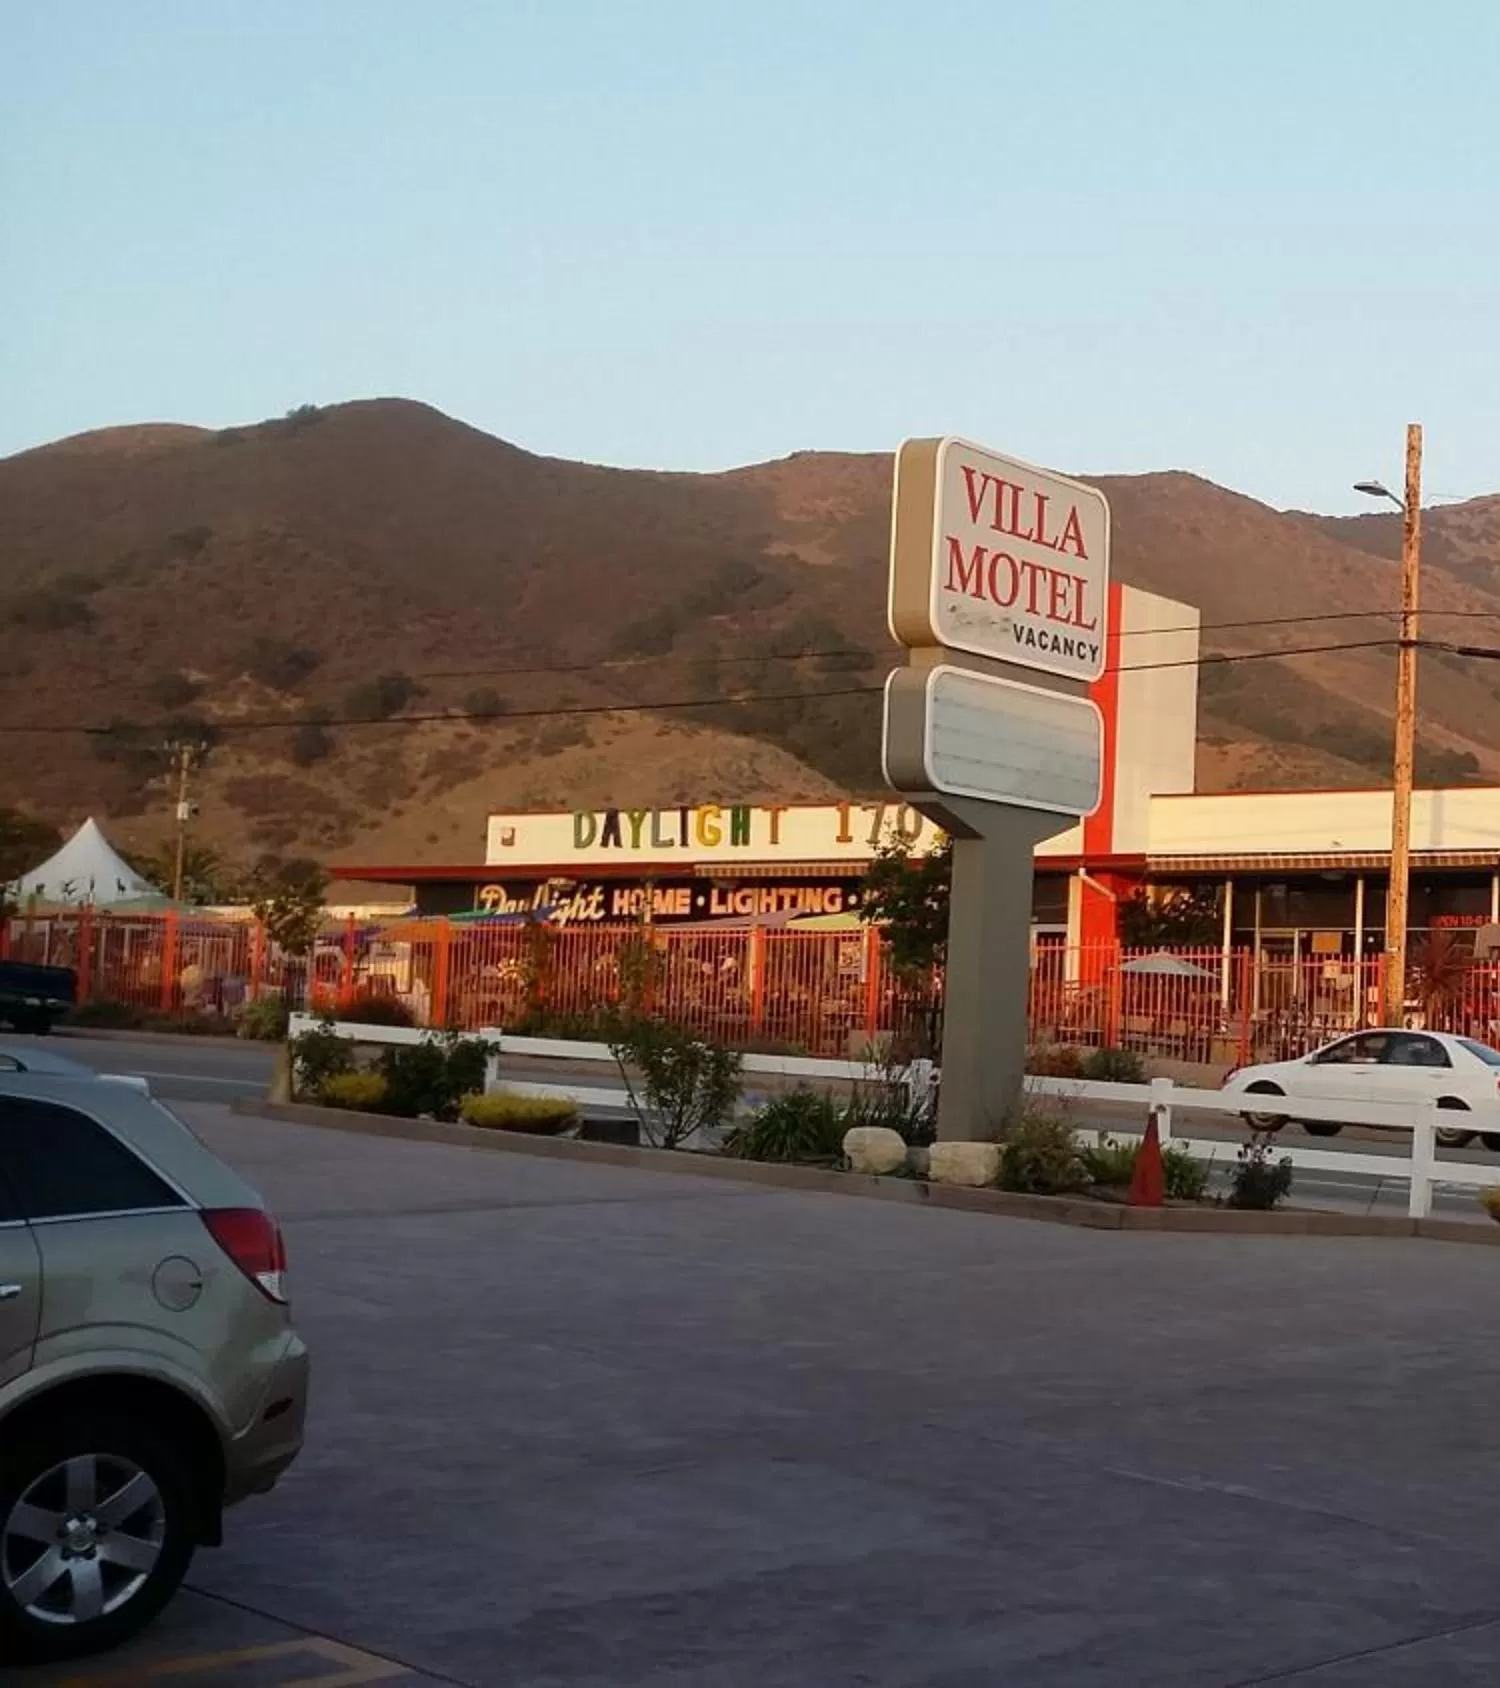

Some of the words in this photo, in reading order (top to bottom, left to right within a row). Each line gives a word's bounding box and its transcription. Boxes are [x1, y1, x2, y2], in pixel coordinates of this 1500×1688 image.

[960, 465, 1089, 561] VILLA
[944, 535, 1098, 632] MOTEL
[1013, 623, 1099, 663] VACANCY
[573, 801, 789, 849] DAYLIGHT
[611, 888, 692, 916] HOME
[709, 887, 843, 915] LIGHTING
